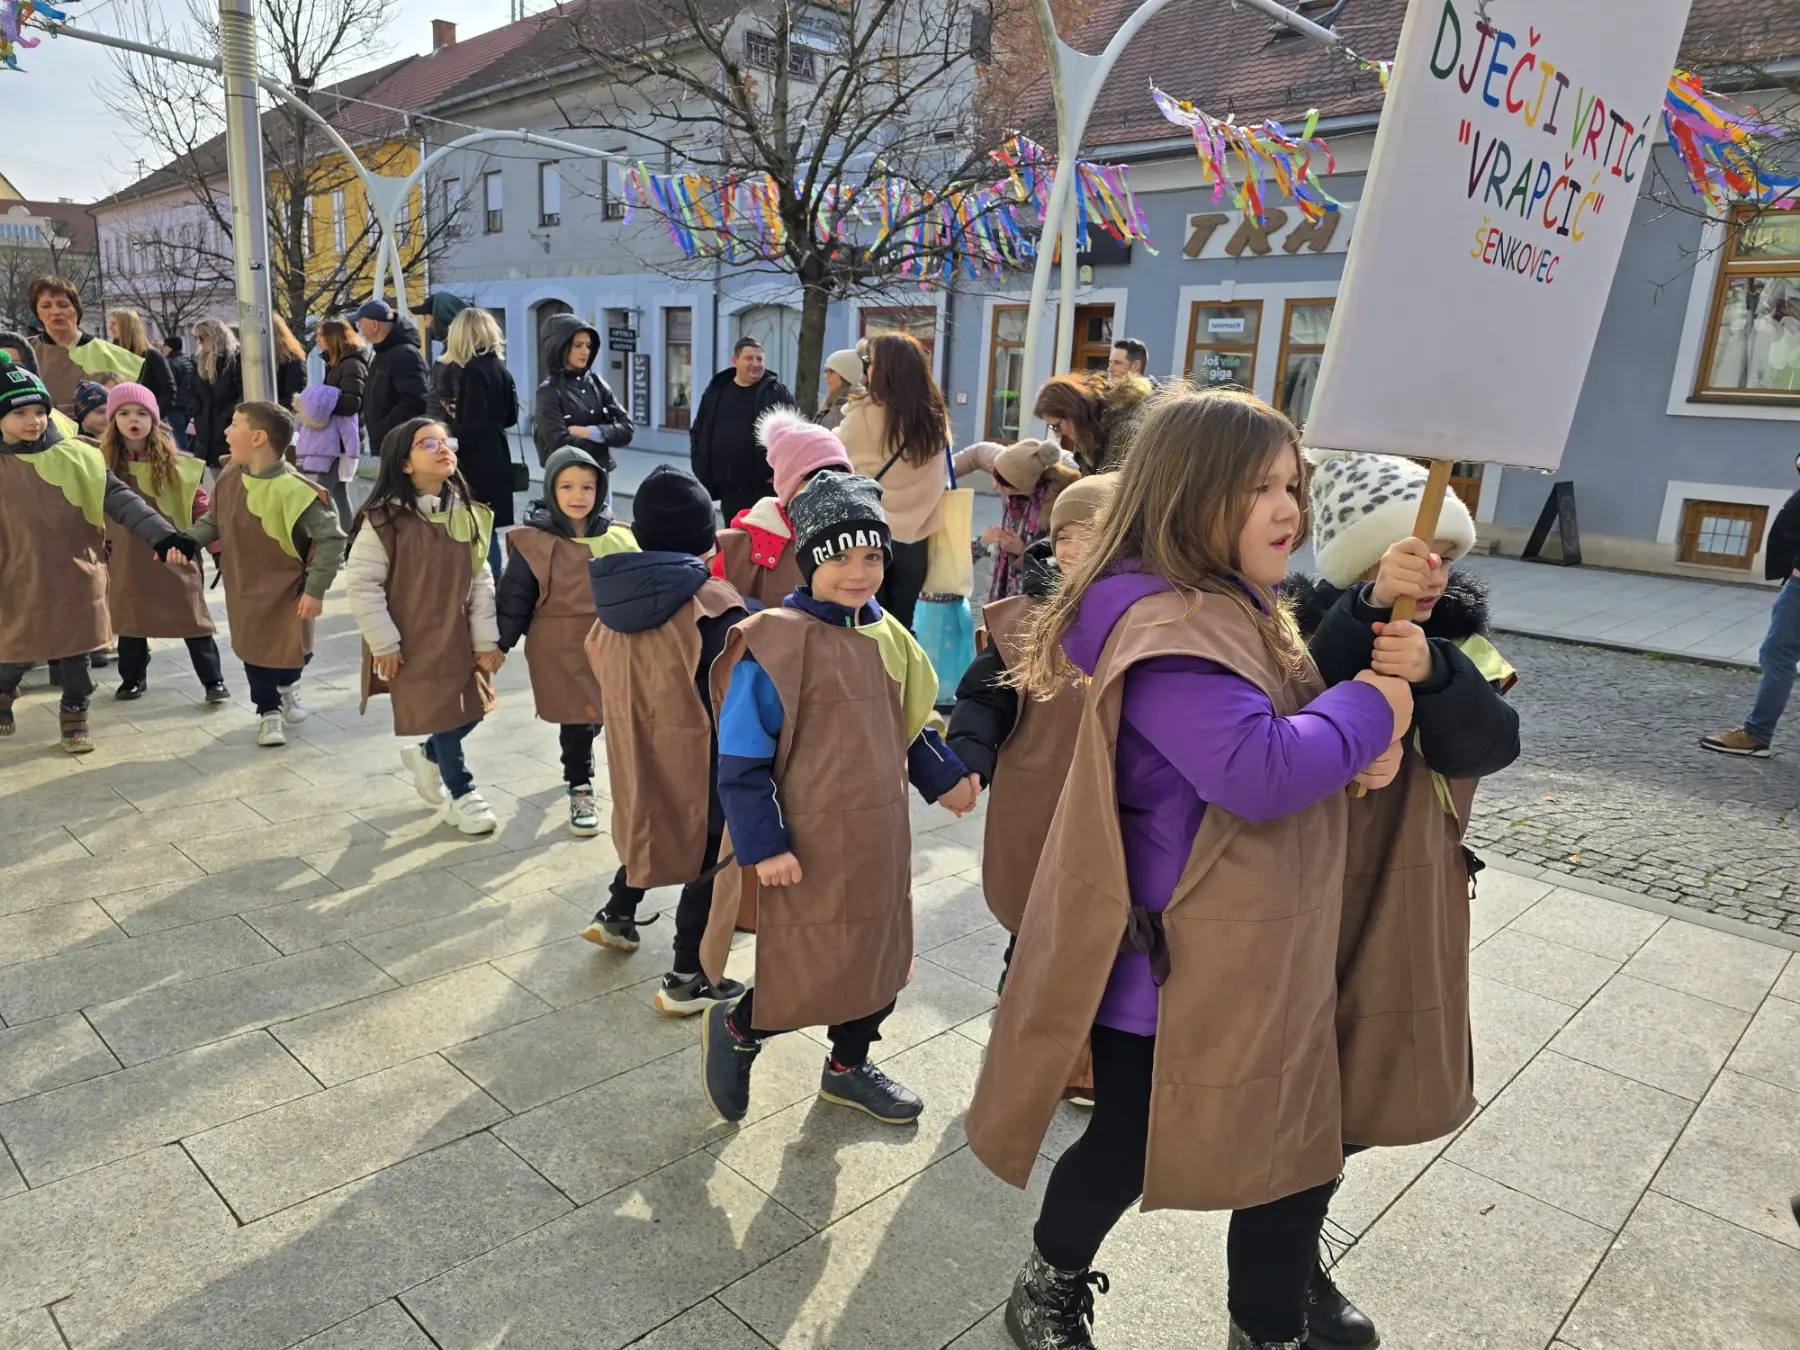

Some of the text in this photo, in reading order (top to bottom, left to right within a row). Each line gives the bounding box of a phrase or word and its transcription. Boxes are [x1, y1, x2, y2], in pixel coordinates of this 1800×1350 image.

[748, 41, 813, 77] TERSA
[1430, 0, 1651, 183] DJEČJI VRTIĆ
[1458, 119, 1604, 241] "VRAPČIĆ"
[1183, 208, 1352, 257] TRA
[1471, 215, 1559, 284] ŠENKOVEC
[1202, 355, 1219, 366] Još
[1210, 366, 1232, 381] giga
